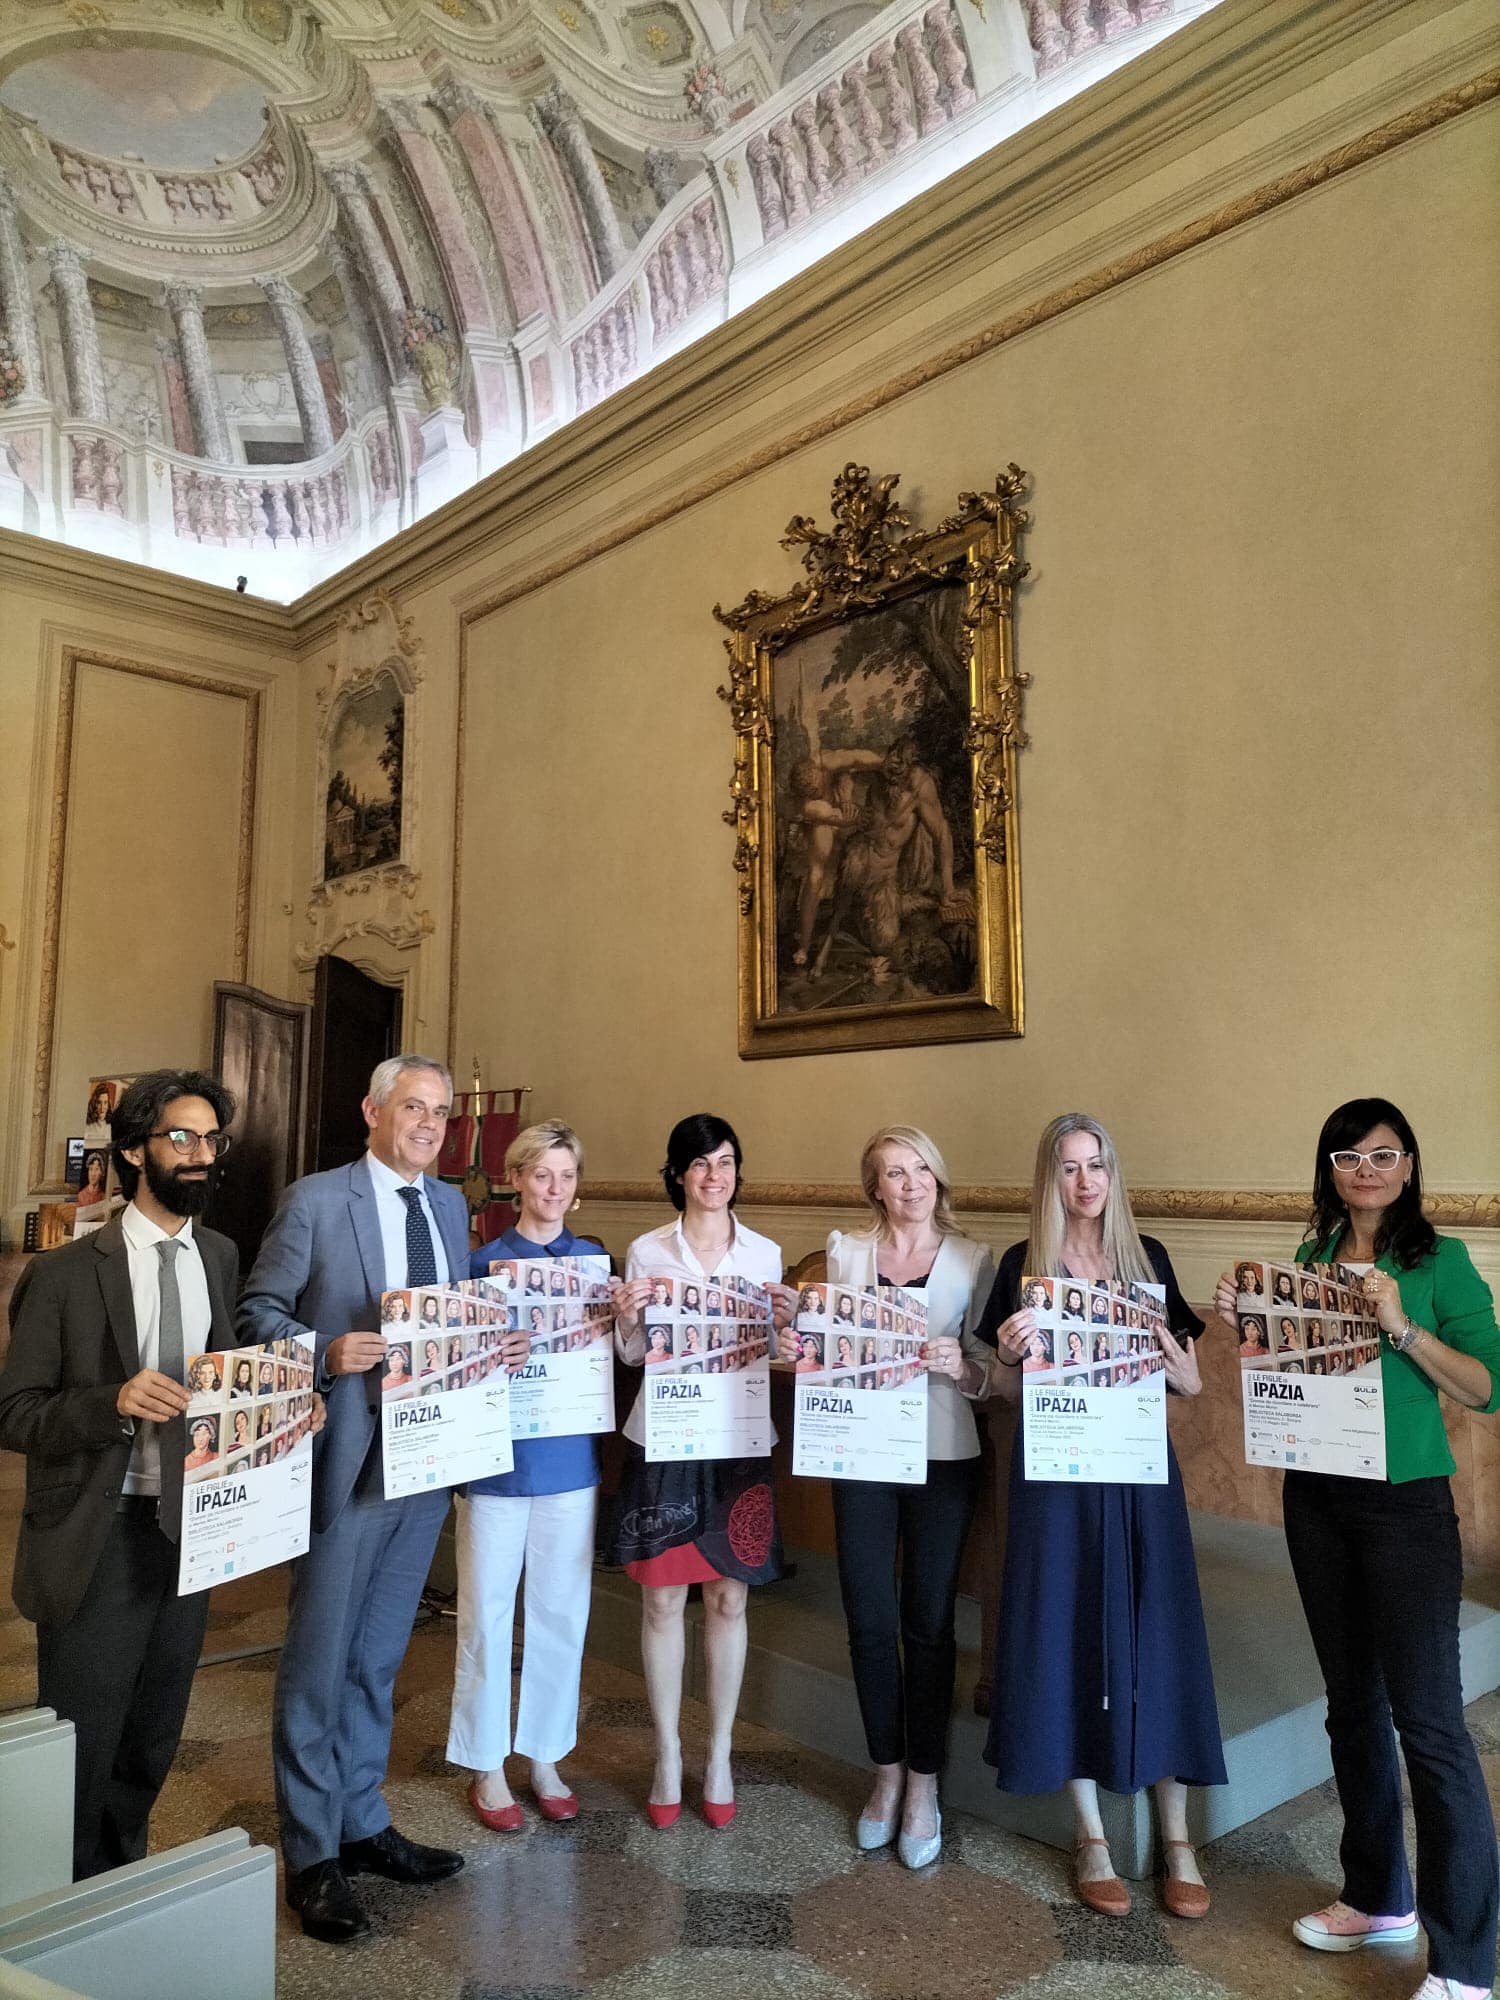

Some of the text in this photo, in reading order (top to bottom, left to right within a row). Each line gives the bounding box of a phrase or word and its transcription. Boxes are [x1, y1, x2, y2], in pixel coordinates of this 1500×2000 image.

[1262, 1374, 1282, 1382] FIGLIE
[656, 1384, 702, 1399] IPAZIA
[1253, 1381, 1304, 1400] IPAZIA
[806, 1397, 854, 1414] IPAZIA
[1035, 1396, 1087, 1412] IPAZIA
[394, 1405, 442, 1428] IPAZIA
[196, 1485, 206, 1494] LE
[207, 1480, 228, 1492] FIGLIE
[196, 1484, 246, 1514] IPAZIA
